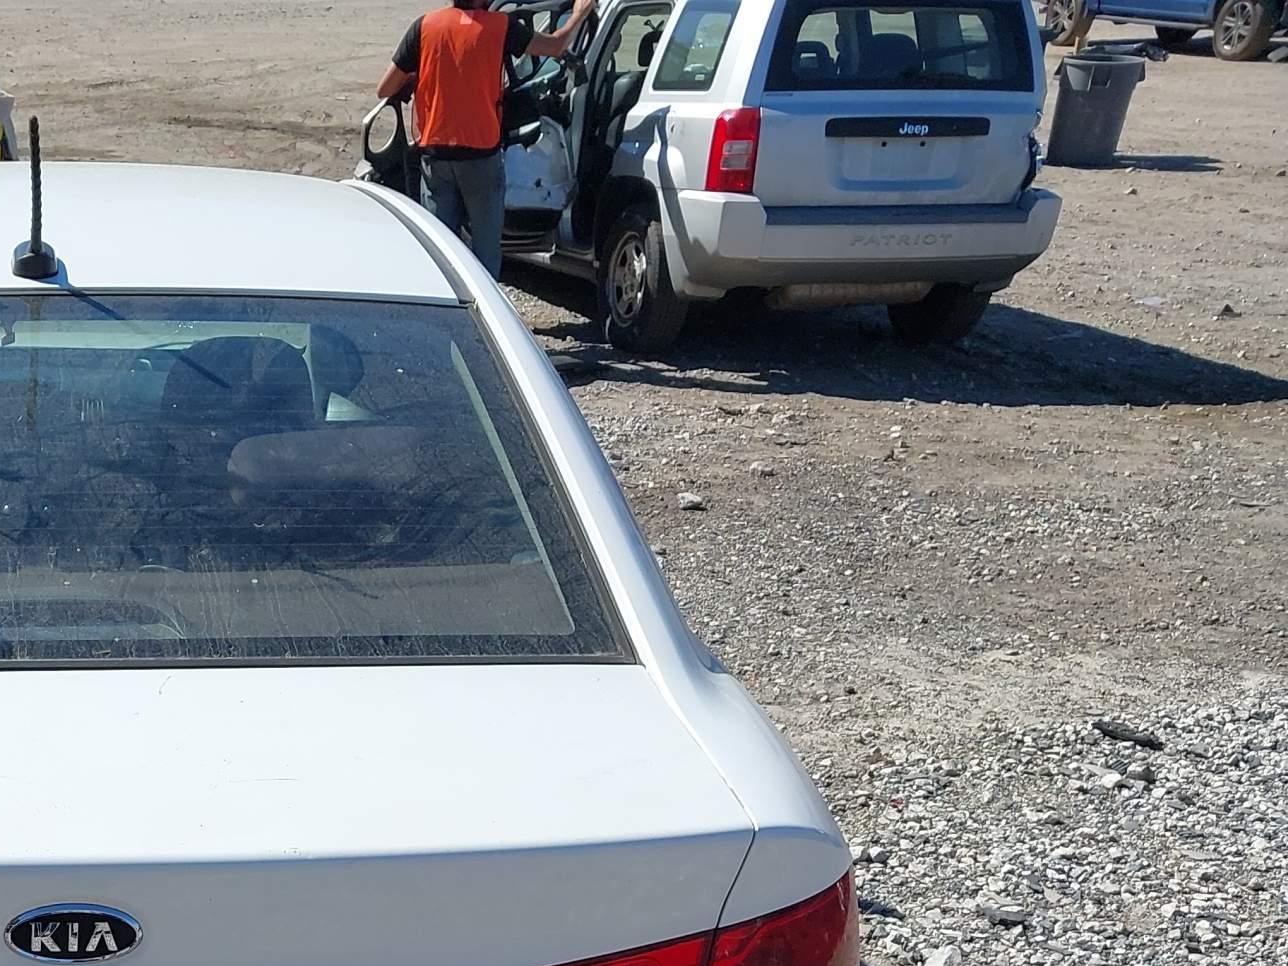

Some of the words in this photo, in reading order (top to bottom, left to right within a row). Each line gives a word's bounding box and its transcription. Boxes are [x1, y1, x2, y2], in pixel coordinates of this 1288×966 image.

[899, 122, 929, 136] Jeep
[850, 233, 954, 247] PATRIOT
[29, 921, 119, 953] KIA
